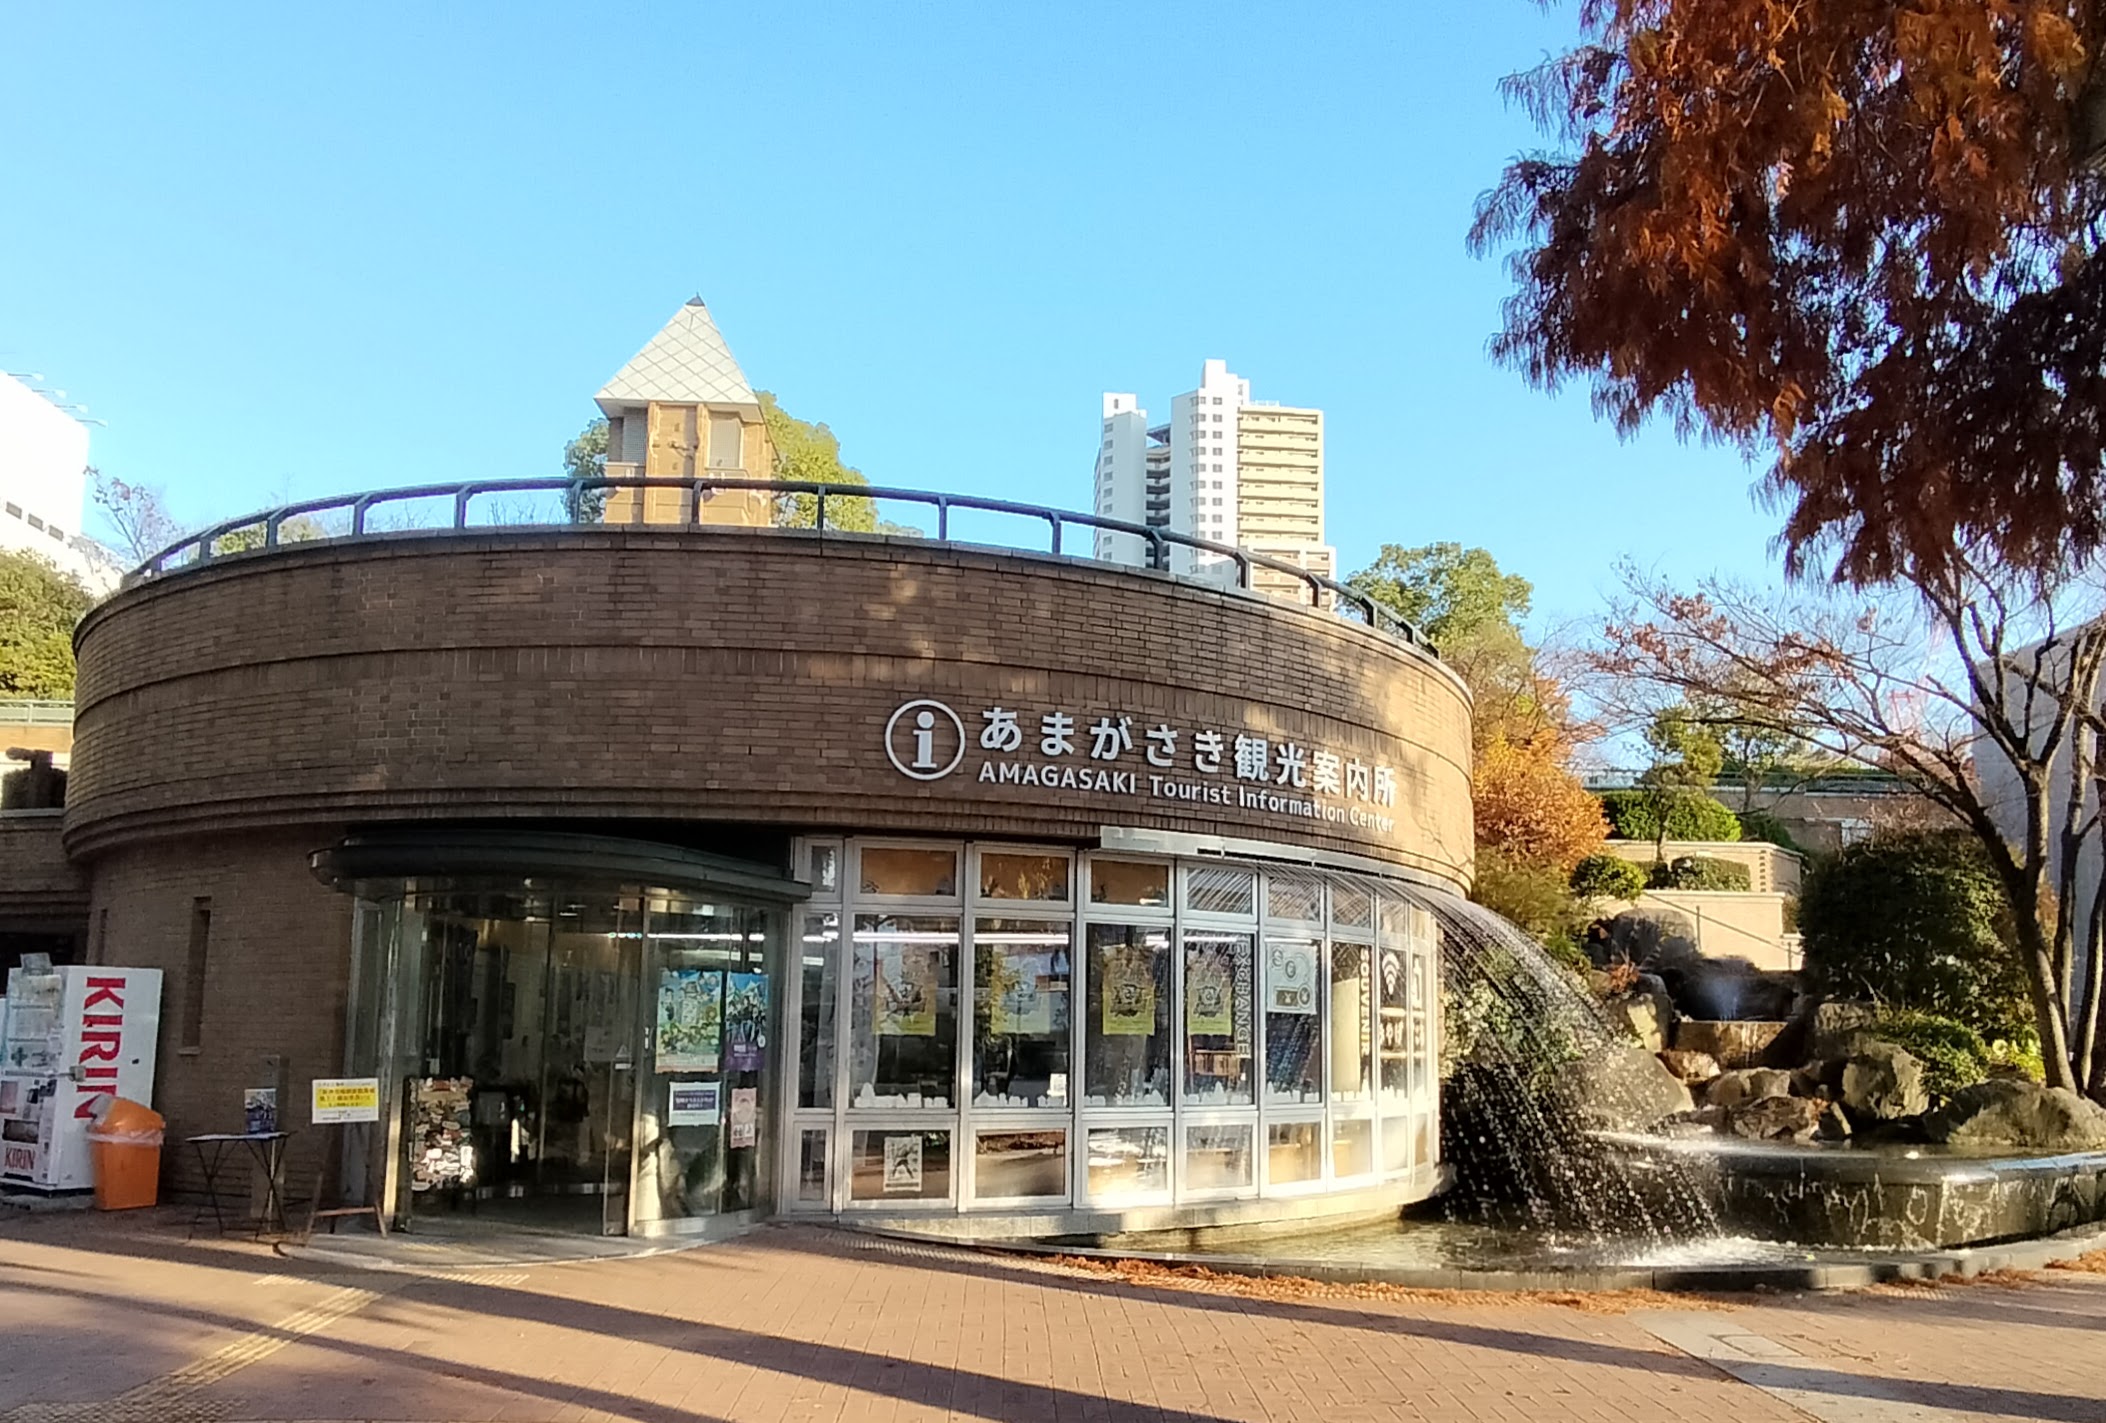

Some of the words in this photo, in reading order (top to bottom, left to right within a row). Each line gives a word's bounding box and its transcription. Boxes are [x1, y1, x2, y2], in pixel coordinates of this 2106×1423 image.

[978, 761, 1136, 795] AMAGASAKI
[1149, 775, 1231, 805] Tourist
[1239, 785, 1345, 824] Information
[1349, 806, 1395, 833] Center
[980, 707, 1397, 808] あまがさき観光案内所
[74, 976, 126, 1119] KIRIN
[1235, 938, 1251, 1055] EXCHANGE
[1360, 948, 1371, 1057] SOUVENIR
[4, 1147, 36, 1171] KIRIN
